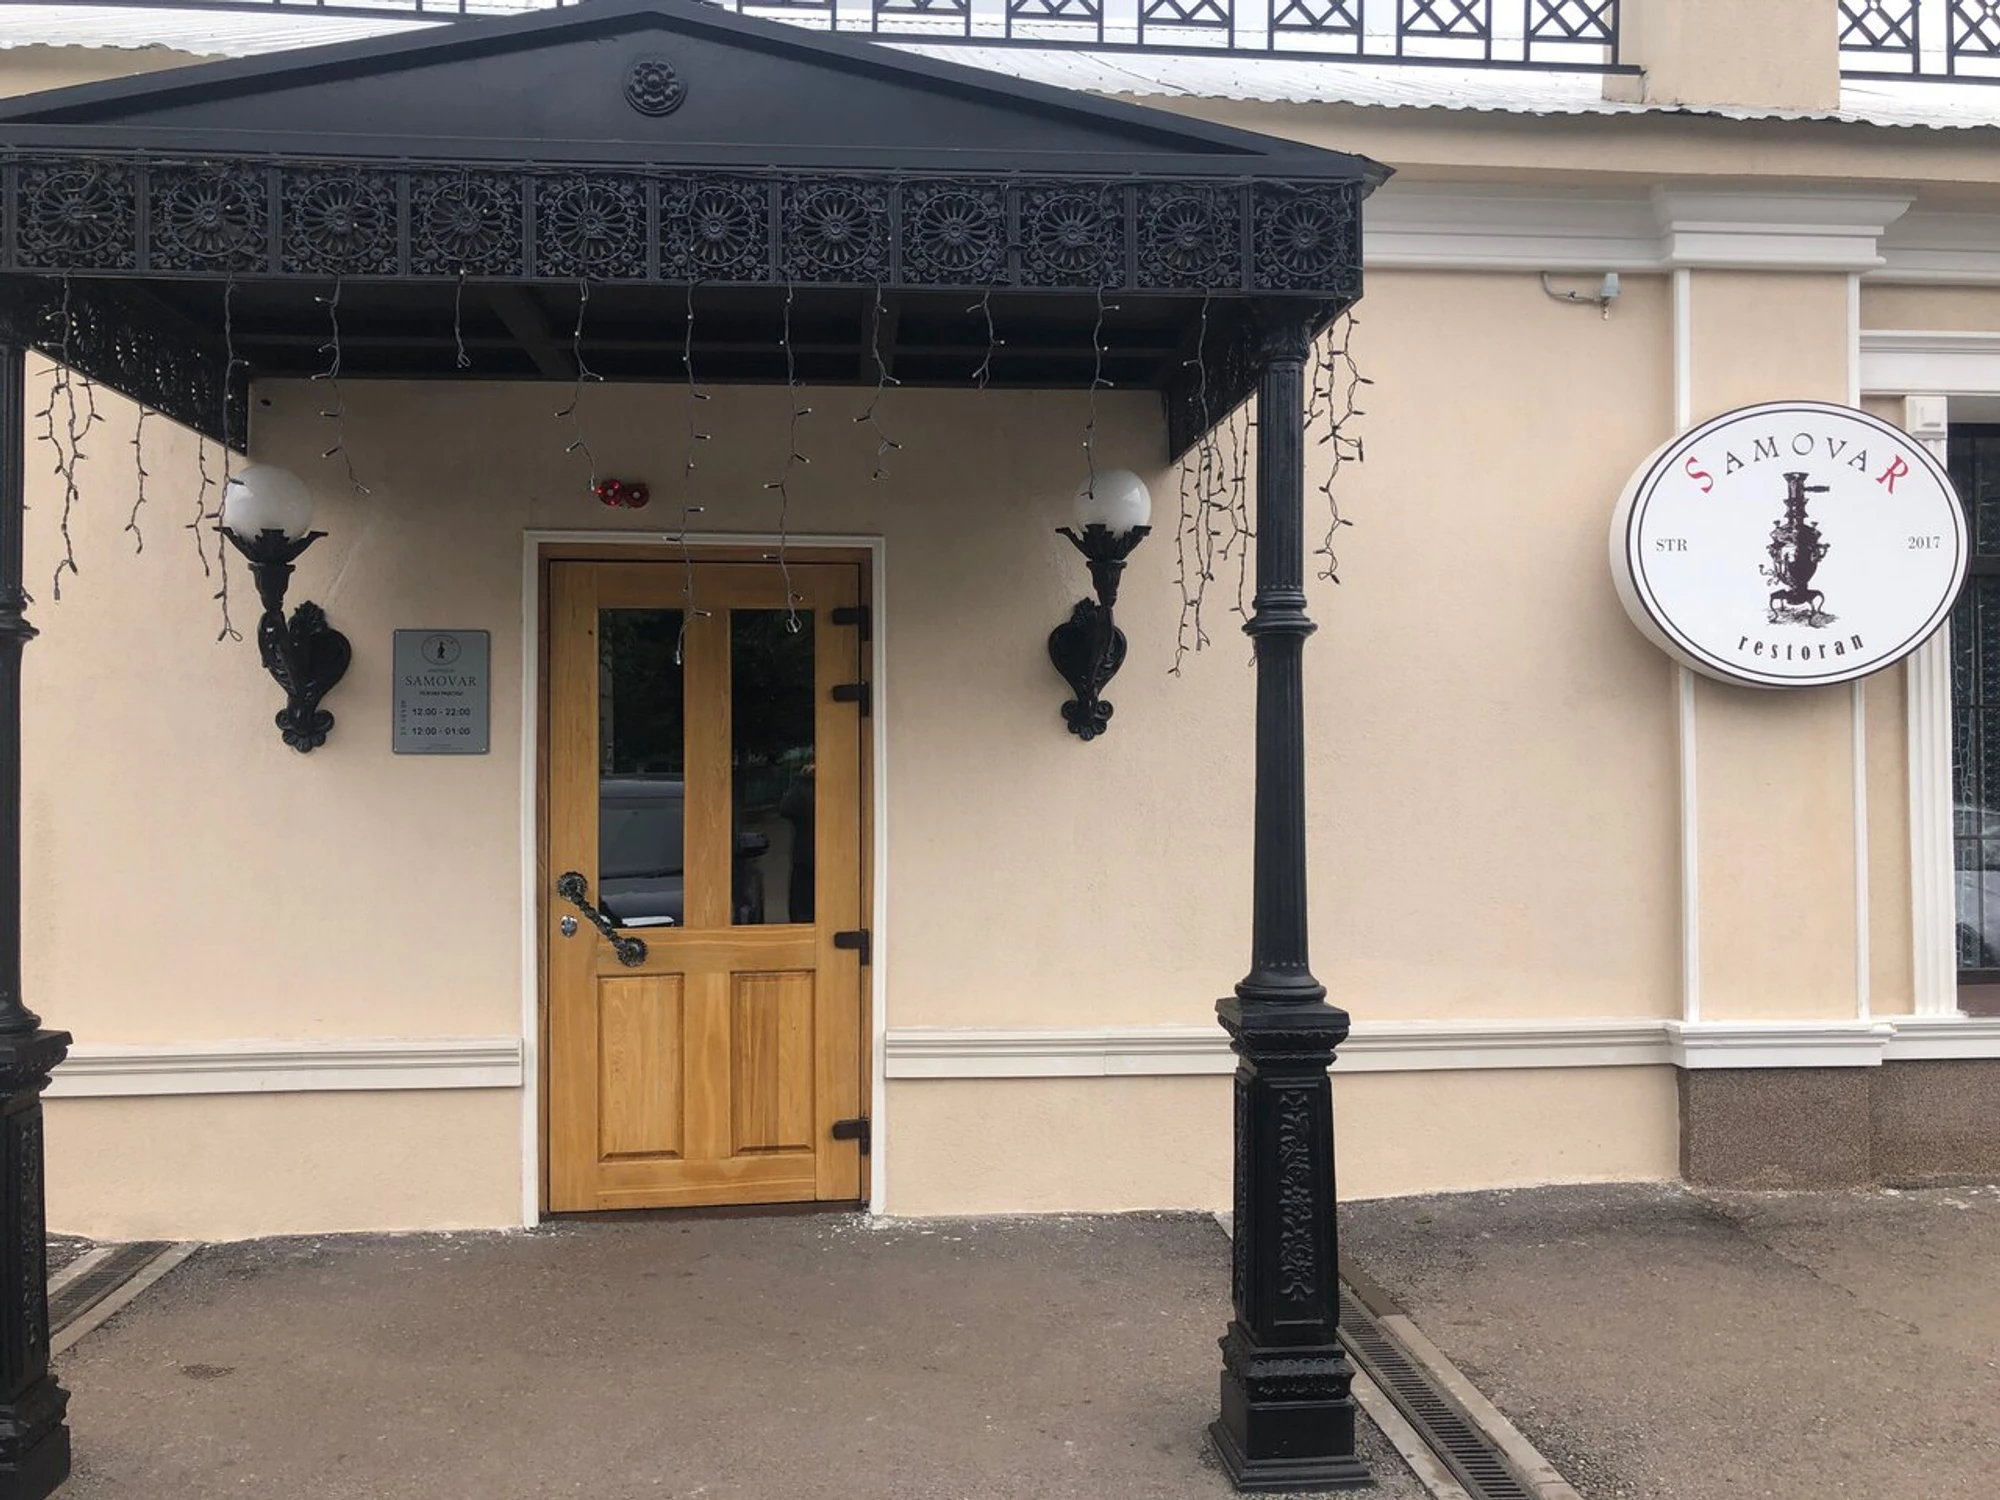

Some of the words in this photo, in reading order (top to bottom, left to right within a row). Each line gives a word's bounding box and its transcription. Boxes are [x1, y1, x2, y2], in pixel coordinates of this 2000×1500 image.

[1685, 433, 1910, 494] SAMOVAR
[1655, 538, 1688, 552] STR
[1907, 536, 1941, 549] 2017
[1738, 633, 1864, 661] restoran
[405, 675, 477, 687] SAMOVAR
[445, 708, 471, 716] 22:00
